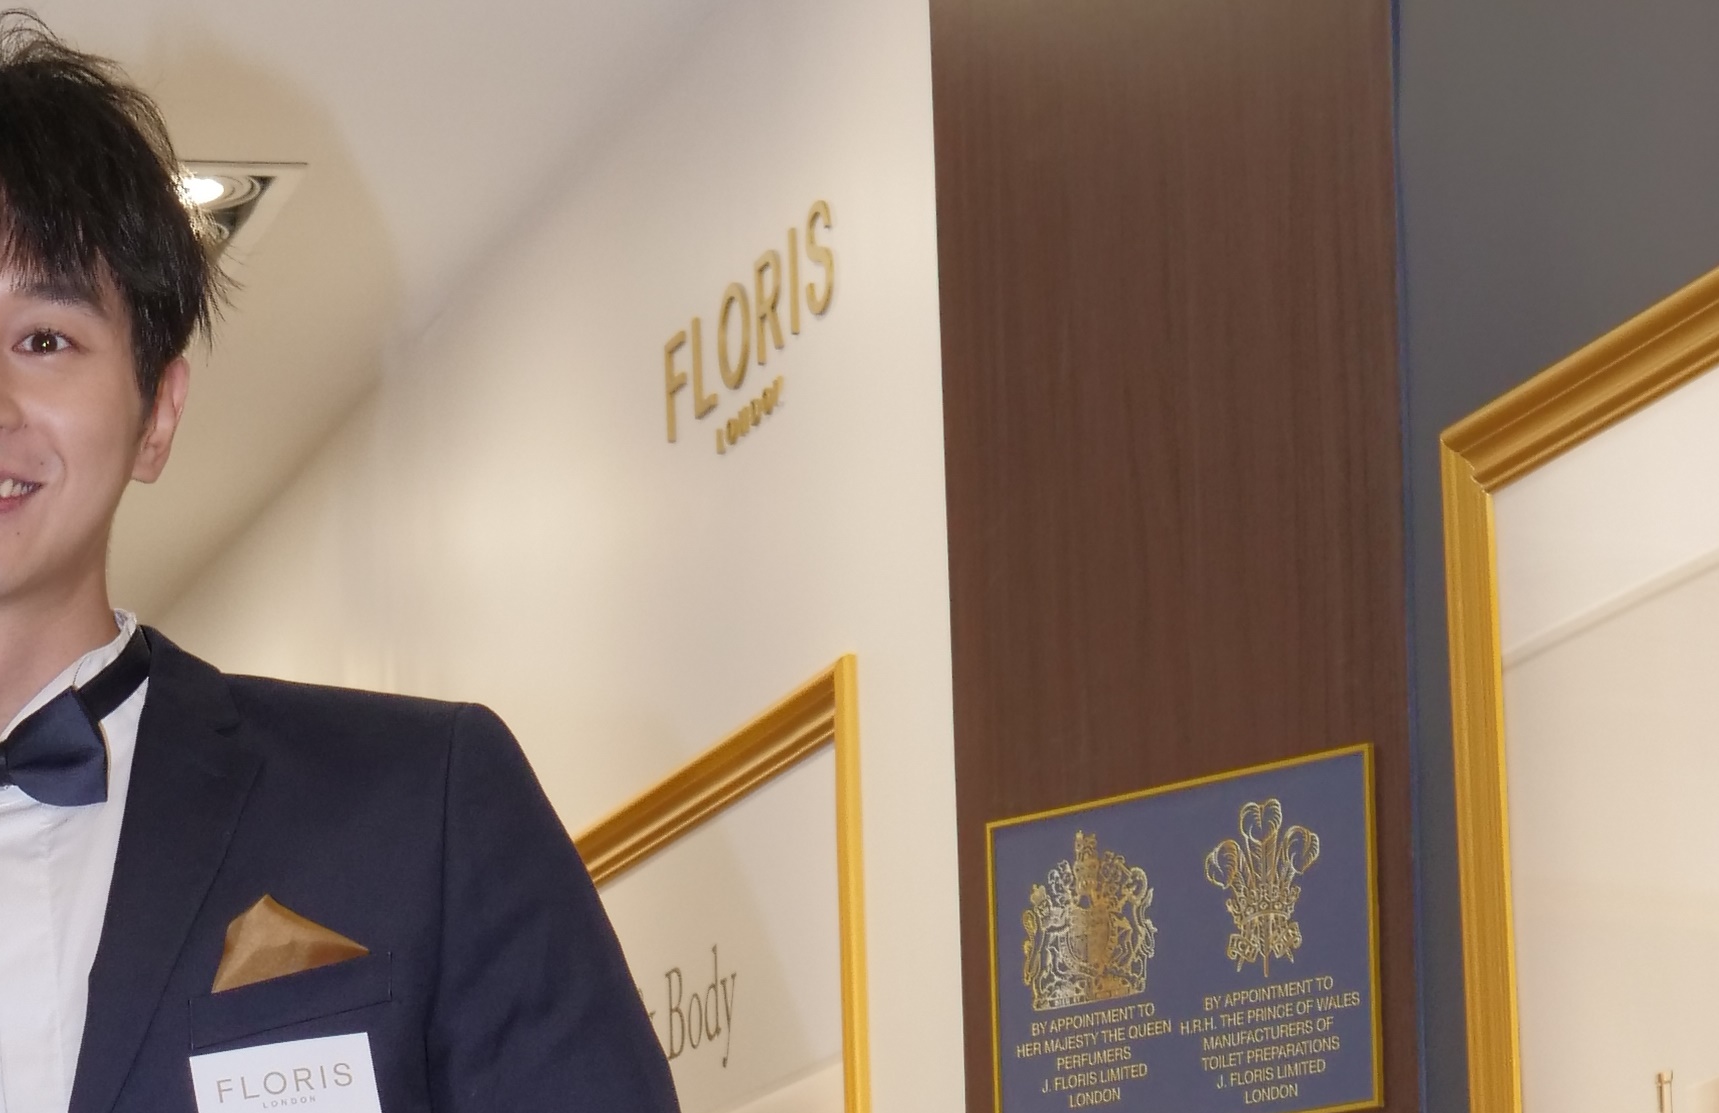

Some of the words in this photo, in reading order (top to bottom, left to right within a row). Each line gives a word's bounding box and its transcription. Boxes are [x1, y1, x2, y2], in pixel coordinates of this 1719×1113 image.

[664, 200, 835, 444] FLORIS
[716, 374, 784, 455] LONDON
[665, 943, 737, 1069] Body
[1204, 995, 1221, 1012] BY
[1224, 979, 1313, 1008] APPOINTMENT
[1316, 975, 1334, 991] TO
[1031, 1021, 1048, 1037] BY
[1050, 1005, 1136, 1034] APPOINTMENT
[1139, 1002, 1156, 1018] TO
[1180, 1017, 1217, 1036] H.R.H.
[1220, 1011, 1244, 1027] THE
[1247, 1002, 1294, 1024] PRINCE
[1296, 998, 1315, 1015] OF
[1316, 991, 1361, 1012] WALES
[1016, 1042, 1042, 1059] HER
[1044, 1030, 1099, 1054] MAJESTY
[1102, 1026, 1126, 1044] THE
[1128, 1020, 1172, 1039] QUEEN
[1202, 1019, 1313, 1051] MANUFACTURERS
[1316, 1016, 1335, 1032] OF
[1057, 1046, 1132, 1071] PERFUMERS
[1202, 1051, 1244, 1071] TOILET
[1246, 1035, 1340, 1064] PREPARATIONS
[215, 1062, 354, 1103] FLORIS
[1042, 1079, 1052, 1094] J.
[1054, 1071, 1098, 1091] FLORIS
[1100, 1063, 1148, 1084] LIMITED
[1216, 1074, 1227, 1089] J.
[1229, 1068, 1275, 1087] FLORIS
[1276, 1058, 1326, 1079] LIMITED
[262, 1096, 316, 1109] LONDON
[1069, 1087, 1121, 1108] LONDON
[1245, 1083, 1299, 1104] LONDON
